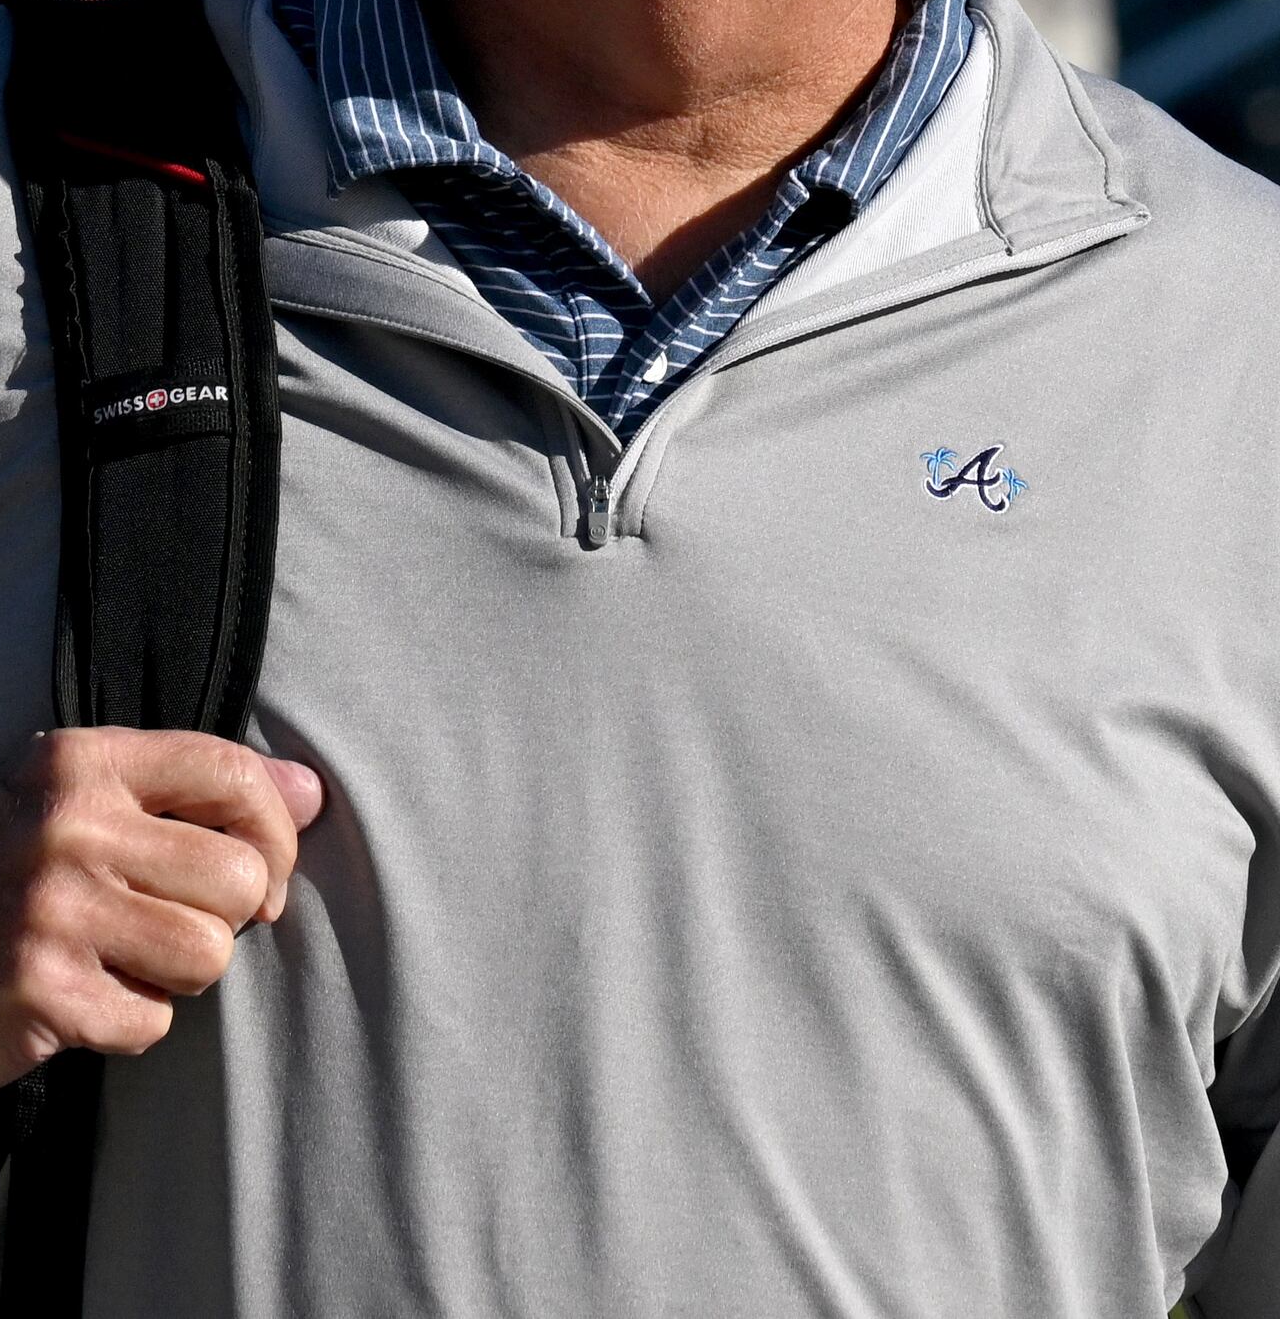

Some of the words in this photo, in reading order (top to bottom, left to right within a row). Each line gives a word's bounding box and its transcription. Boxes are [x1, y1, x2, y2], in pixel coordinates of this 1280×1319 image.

[93, 395, 145, 424] SWISS
[169, 385, 229, 403] GEAR
[924, 444, 1010, 514] A
